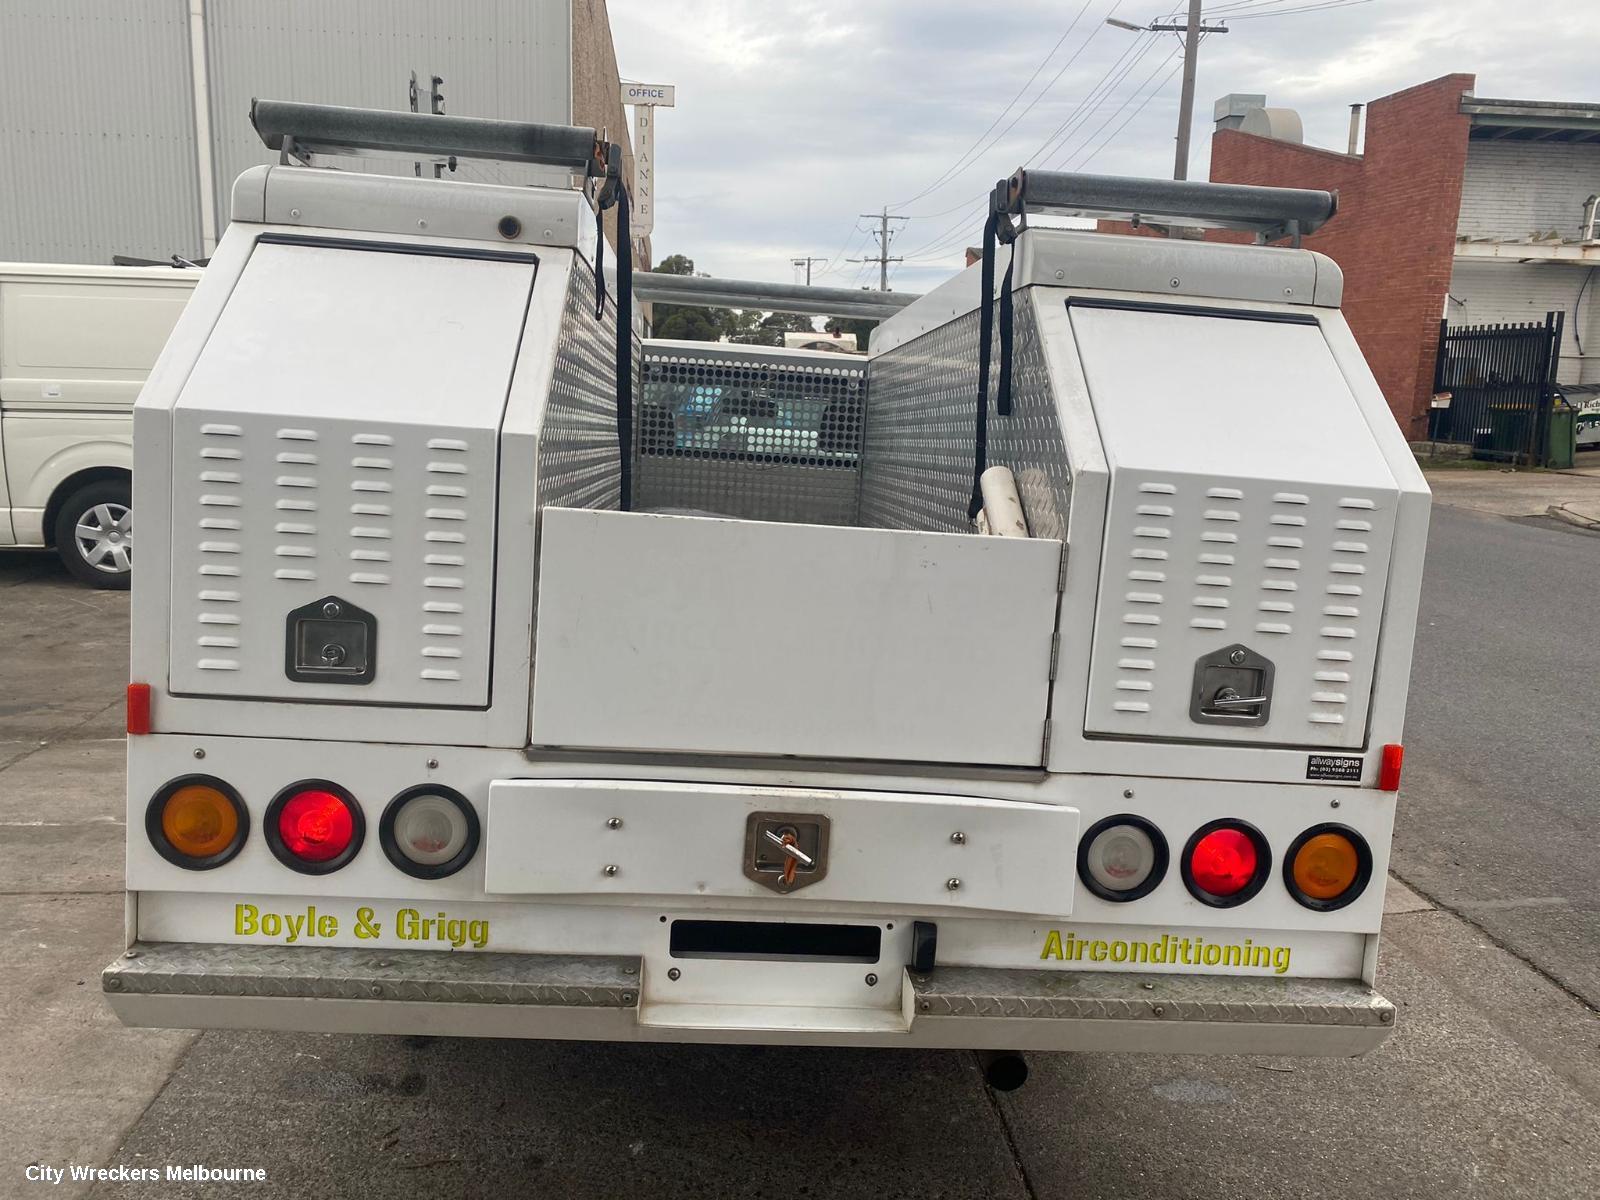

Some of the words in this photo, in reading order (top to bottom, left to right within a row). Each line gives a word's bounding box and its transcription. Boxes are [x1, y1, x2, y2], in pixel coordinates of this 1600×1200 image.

[629, 88, 665, 99] OFFICE
[639, 117, 649, 215] DIANNE
[1310, 757, 1360, 768] allwaysigns
[235, 904, 338, 943] Boyle
[353, 906, 381, 939] &
[396, 908, 489, 949] Grigg
[1040, 930, 1291, 974] Airconditioning
